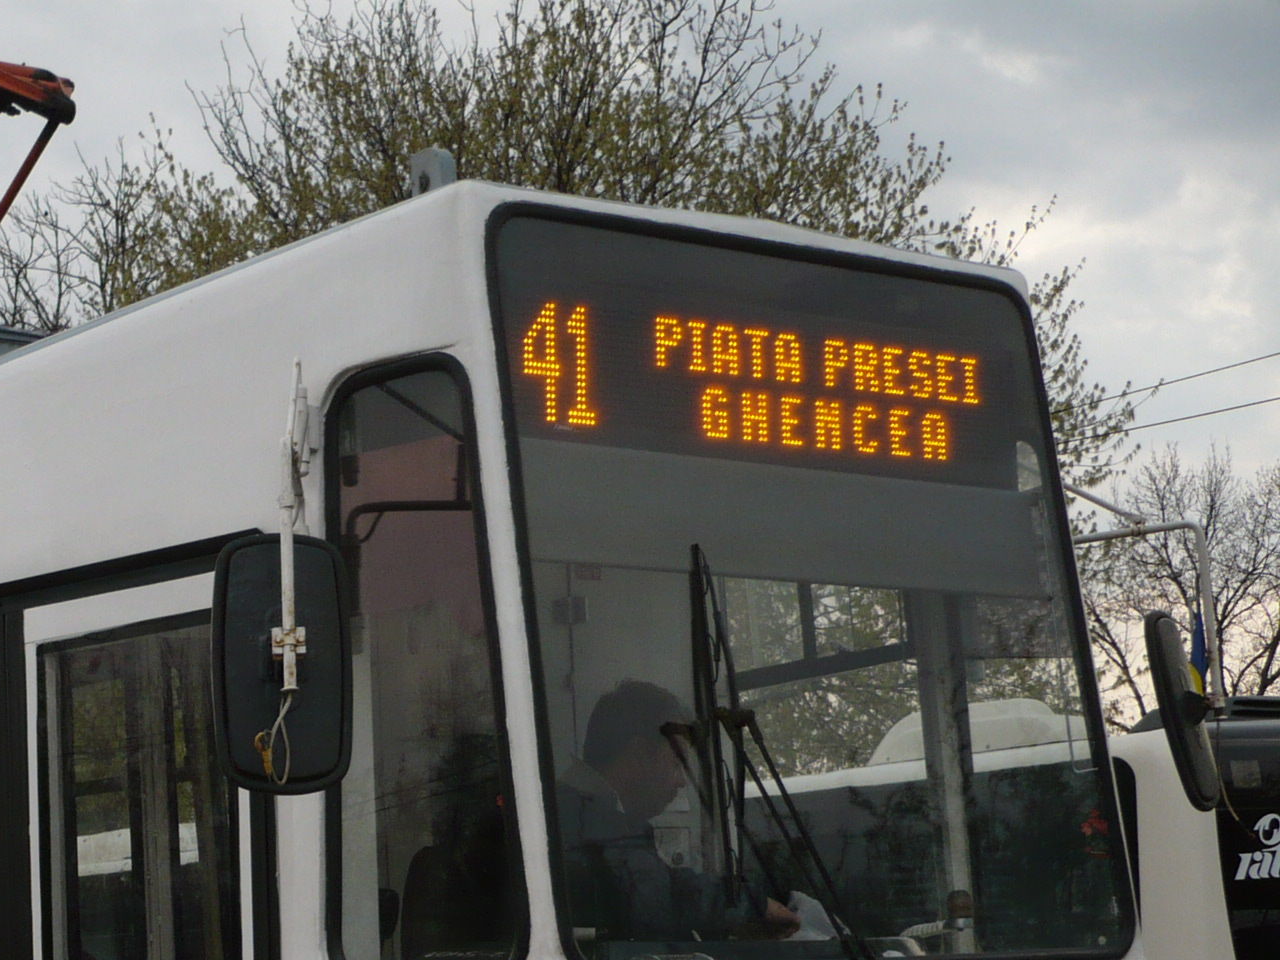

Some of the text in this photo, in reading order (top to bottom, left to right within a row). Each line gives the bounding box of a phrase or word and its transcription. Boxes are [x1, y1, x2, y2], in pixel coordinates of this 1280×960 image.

[523, 302, 596, 426] 41
[655, 316, 979, 404] PIATA PRESEI
[701, 387, 948, 461] GHENCEA
